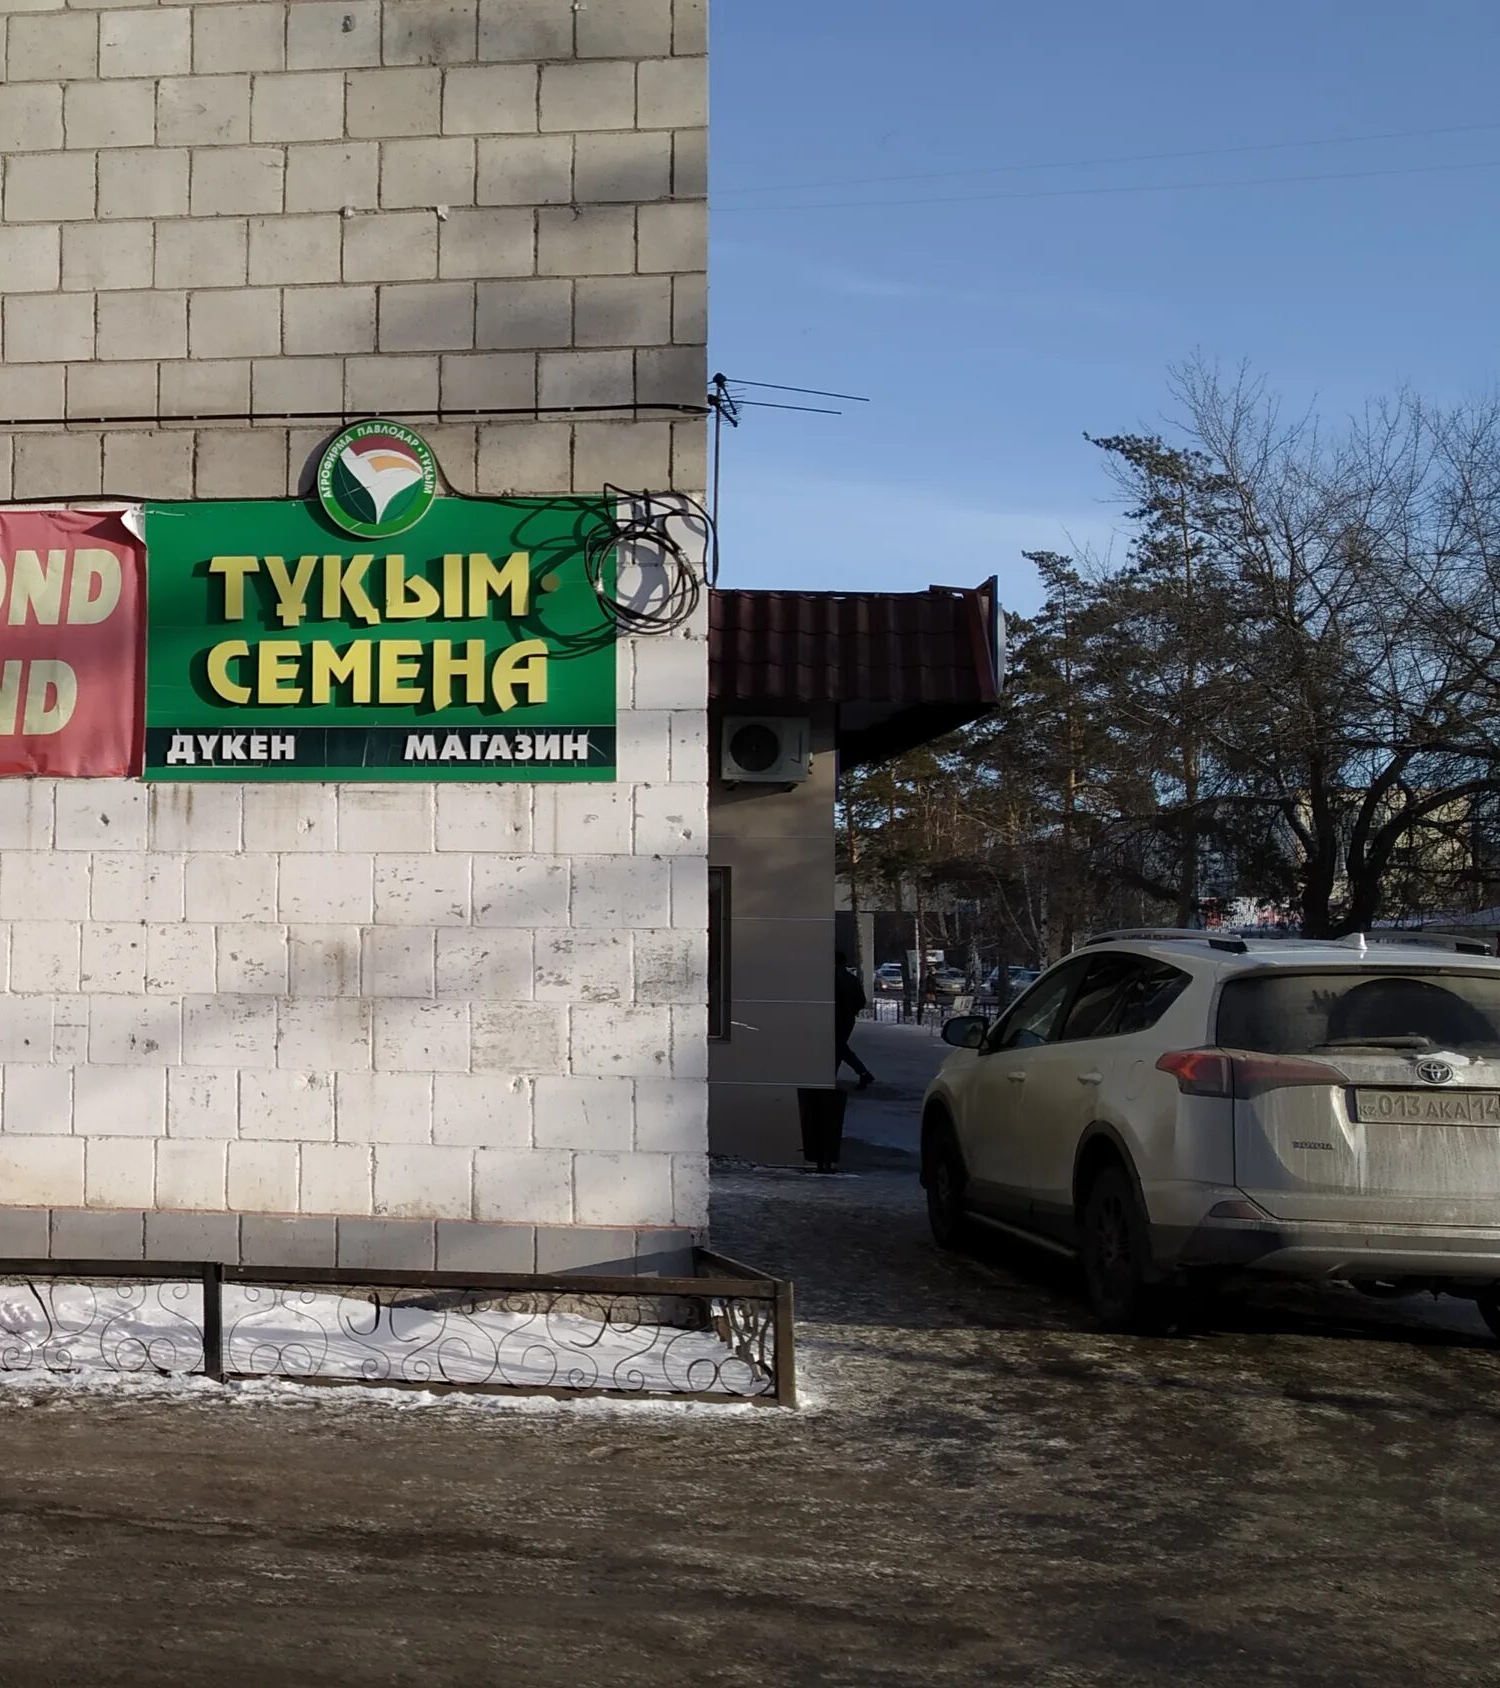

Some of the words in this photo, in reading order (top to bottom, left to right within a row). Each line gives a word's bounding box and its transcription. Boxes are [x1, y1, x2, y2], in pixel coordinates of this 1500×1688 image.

[320, 434, 354, 499] АГРОФИРМА
[357, 425, 420, 447] ПАВЛОДАР
[208, 552, 530, 626] ТҰҚЫМ
[207, 638, 549, 712] СЕМЕНА
[166, 734, 296, 765] ДҮКЕН
[404, 733, 590, 761] МАГАЗИН
[1379, 1094, 1422, 1118] 013
